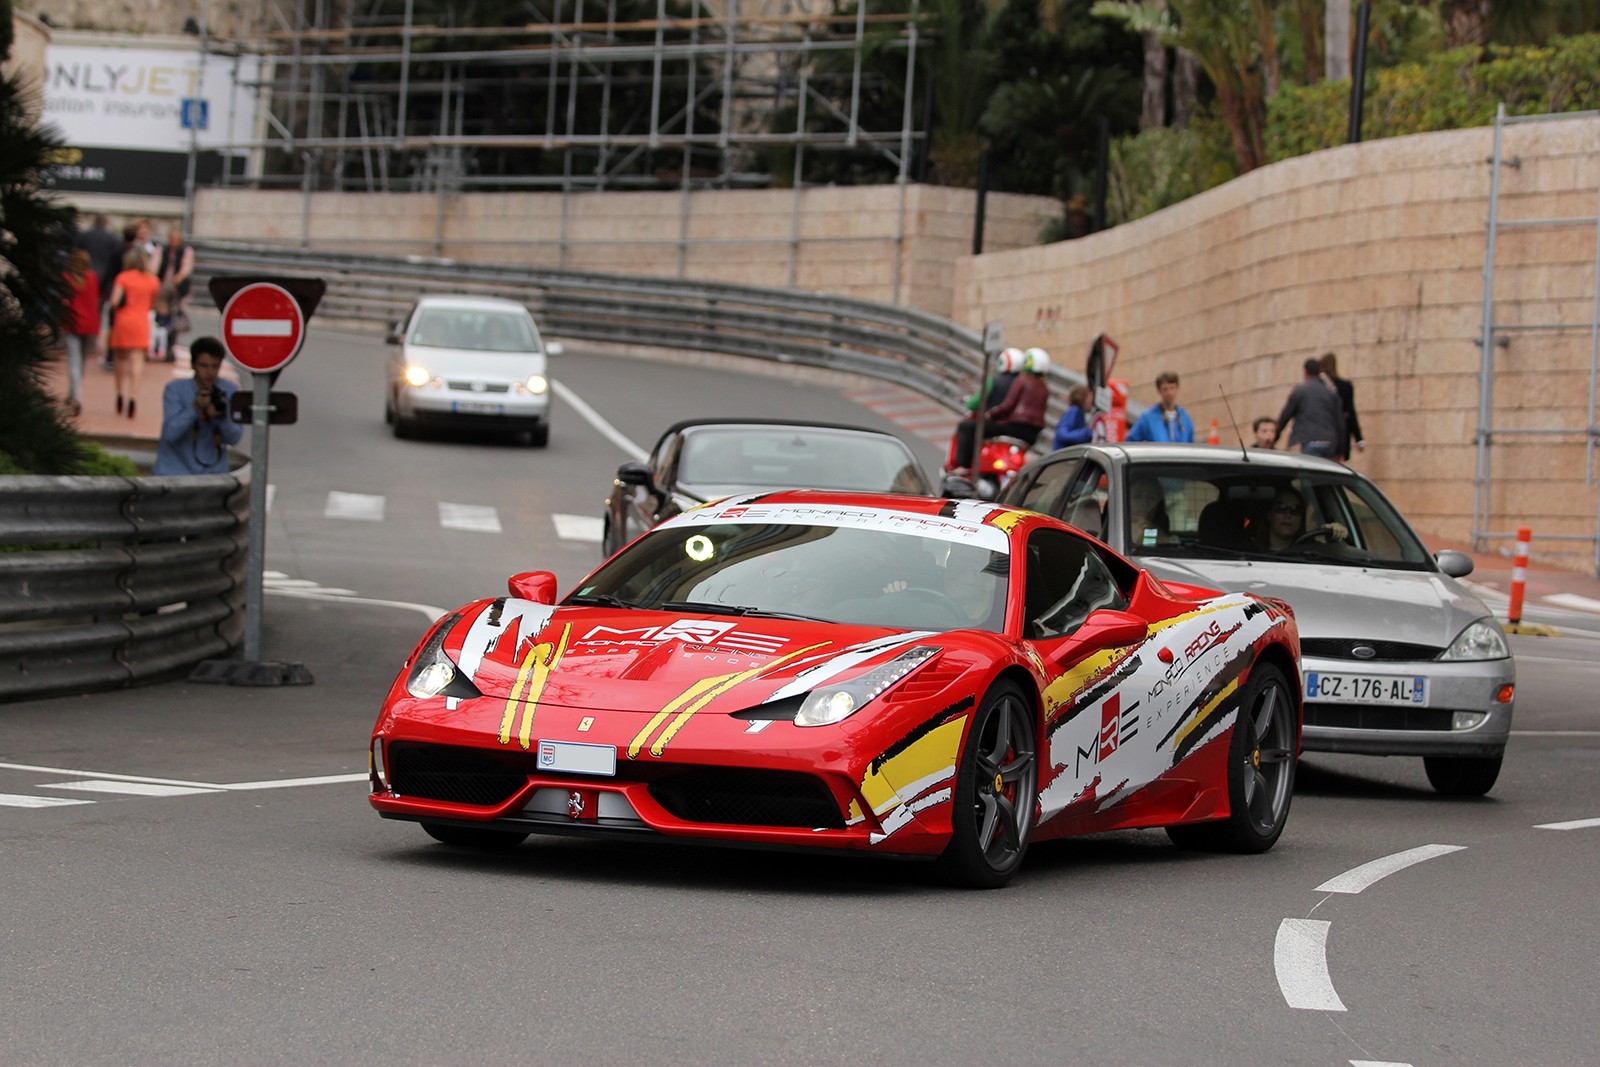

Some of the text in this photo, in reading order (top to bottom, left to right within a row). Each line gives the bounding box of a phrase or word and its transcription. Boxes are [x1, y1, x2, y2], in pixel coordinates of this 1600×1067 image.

[44, 62, 207, 97] NLYJET
[692, 507, 771, 521] MRE
[773, 512, 974, 538] EXPERIENCE
[780, 508, 980, 533] MONACO RACING
[582, 619, 791, 653] MRE
[565, 647, 761, 669] EXPEIENCE
[1147, 619, 1222, 703] MONACO RACING
[1146, 646, 1231, 729] EXPERIENCE
[1320, 676, 1411, 700] CZ-176-AL
[1075, 691, 1140, 779] MRE
